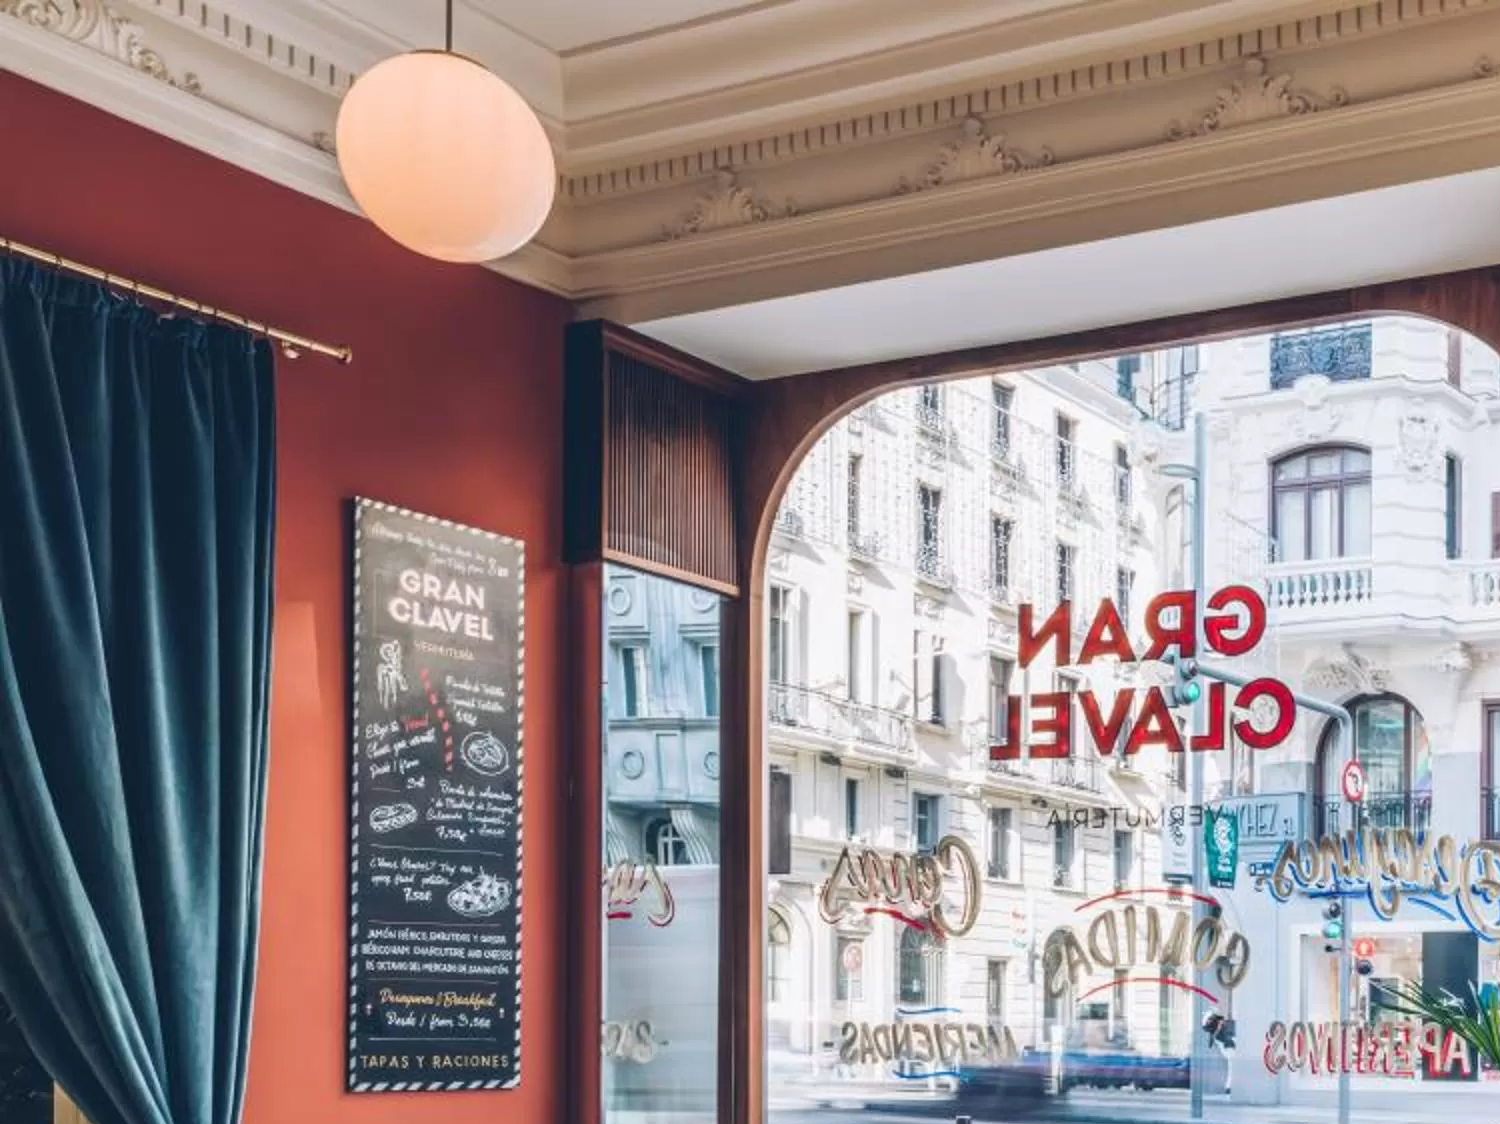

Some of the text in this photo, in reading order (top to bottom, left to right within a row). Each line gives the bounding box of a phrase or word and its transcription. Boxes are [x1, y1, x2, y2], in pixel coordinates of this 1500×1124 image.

[399, 568, 486, 609] GRAN
[387, 597, 494, 641] CLAVEL
[360, 1055, 510, 1070] TAPAS Y RACIONES
